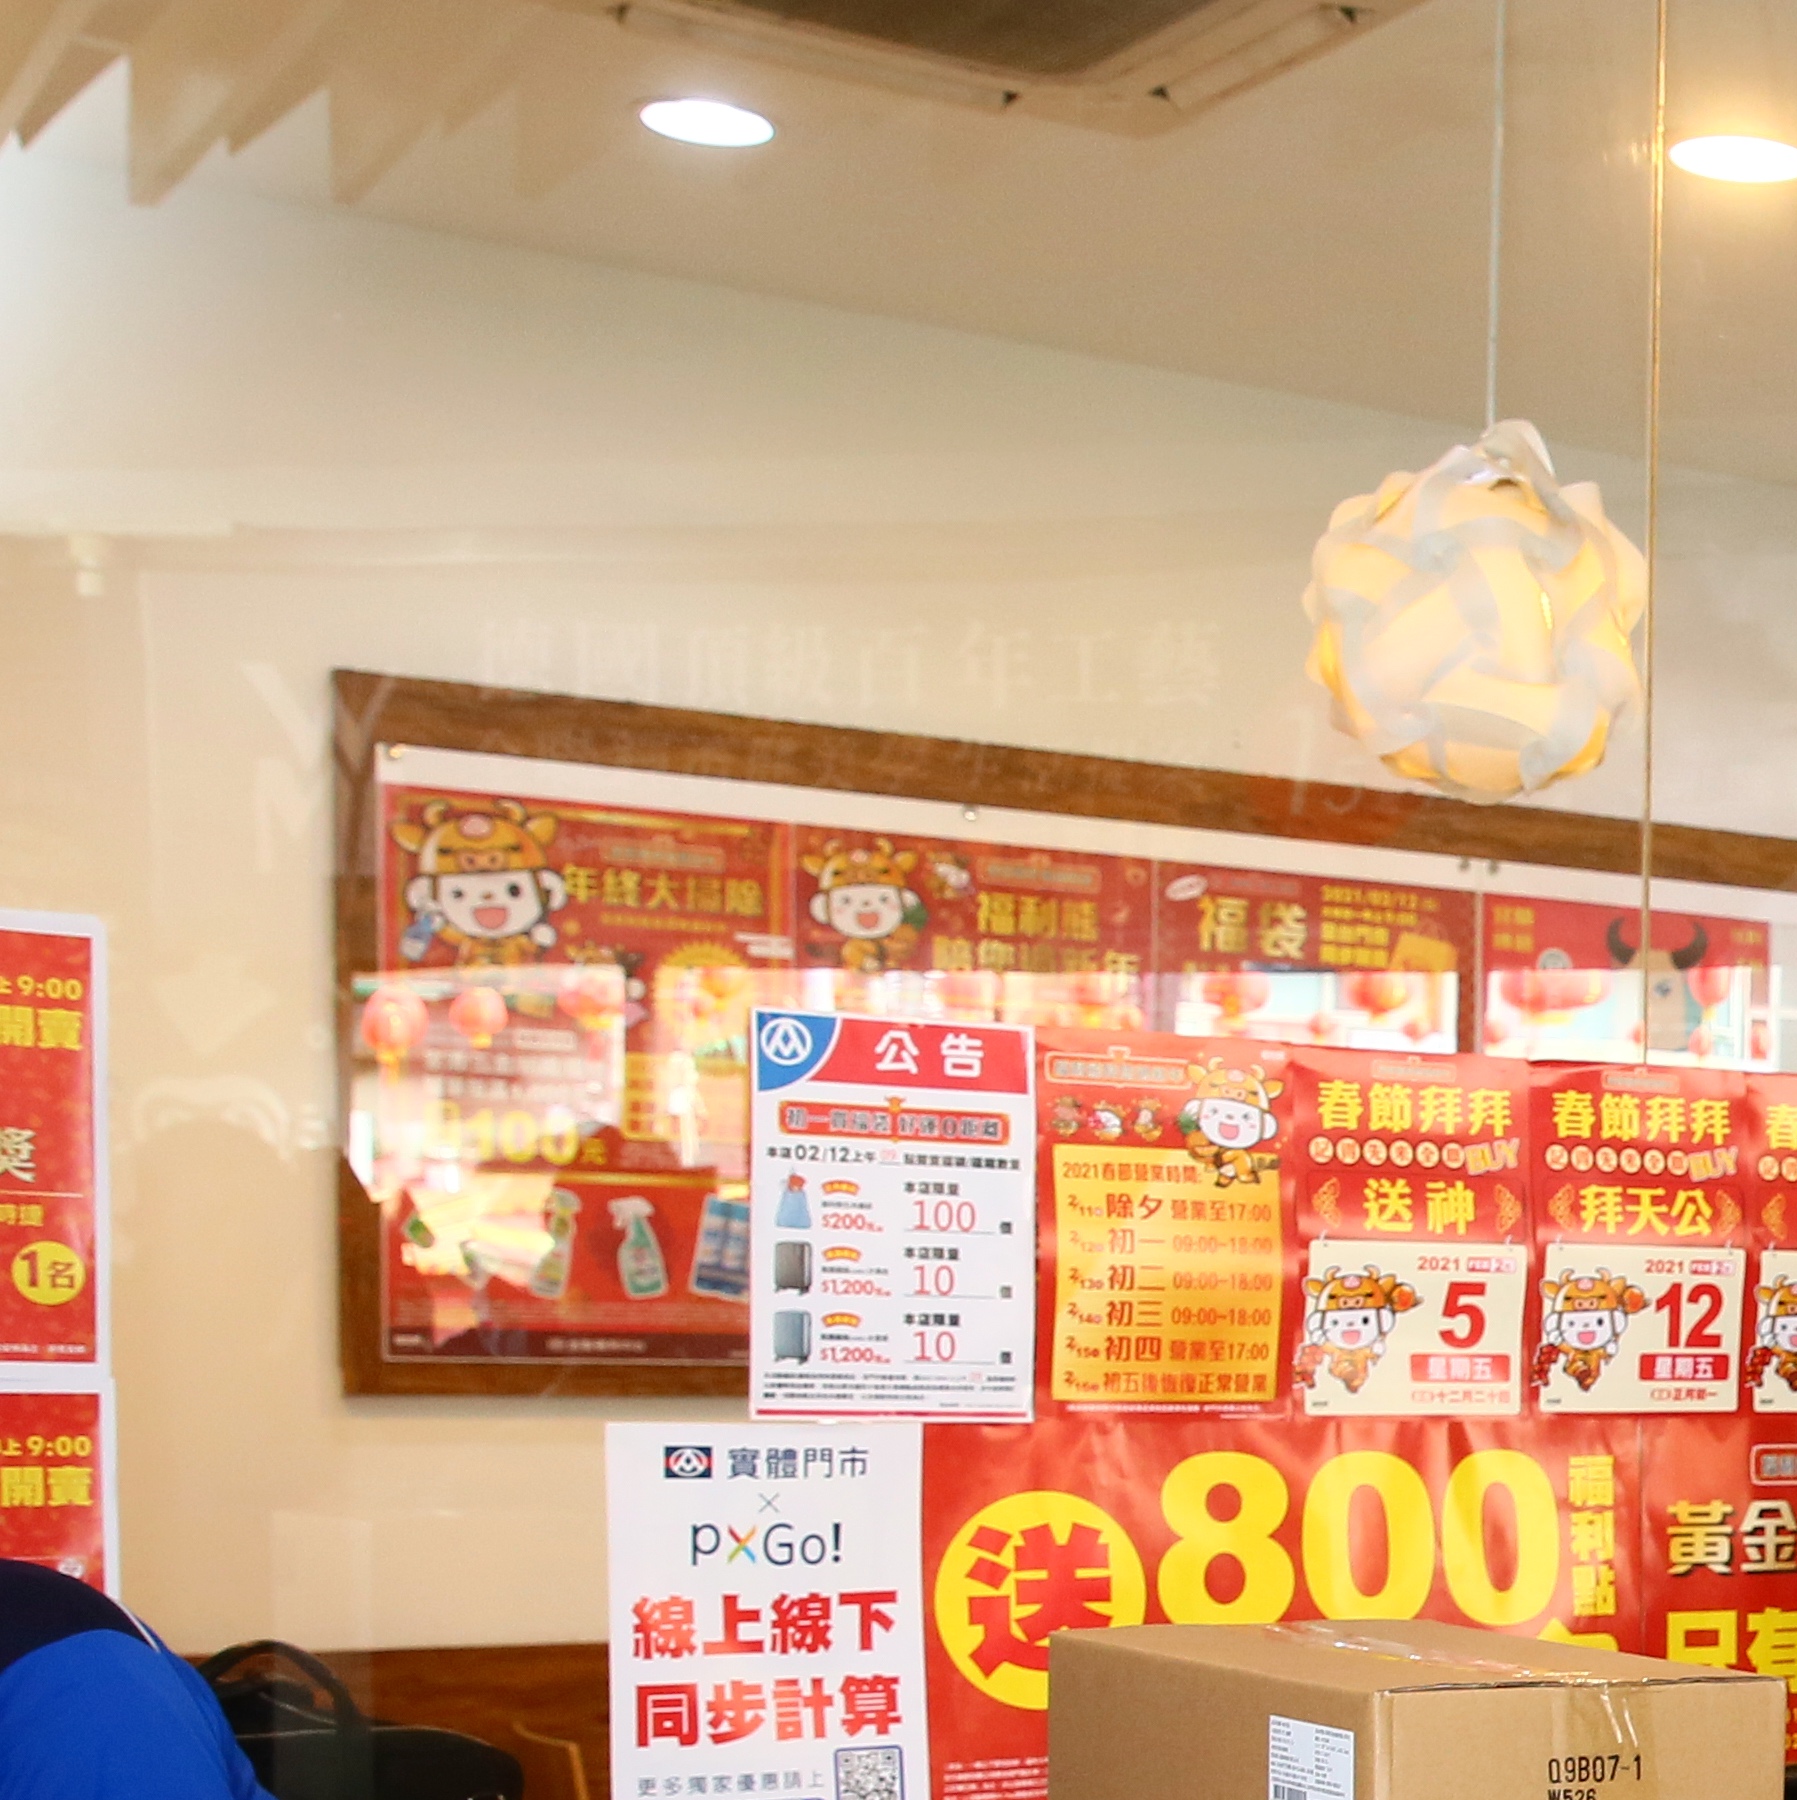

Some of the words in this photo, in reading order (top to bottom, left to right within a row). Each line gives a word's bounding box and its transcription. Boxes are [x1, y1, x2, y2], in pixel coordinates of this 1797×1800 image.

[18, 975, 84, 1000] 9:00
[874, 1029, 984, 1078] 公告
[1317, 1080, 1512, 1136] 春節拜拜
[1551, 1089, 1731, 1145] 春節拜拜
[1464, 1139, 1521, 1176] BUY
[1687, 1147, 1739, 1182] BUY
[913, 1200, 976, 1233] 100
[1106, 1193, 1163, 1220] 除夕
[1363, 1177, 1476, 1235] 送神
[1579, 1184, 1714, 1237] 拜天公
[1108, 1228, 1165, 1254] 初一
[19, 1250, 77, 1290] 1名
[913, 1264, 955, 1297] 10
[1108, 1265, 1165, 1291] 初二
[1417, 1257, 1461, 1272] 2021
[1644, 1259, 1685, 1274] 2021
[1107, 1300, 1163, 1327] 初三
[1438, 1281, 1487, 1349] 5
[1655, 1281, 1723, 1349] 12
[913, 1330, 956, 1363] 10
[1106, 1336, 1162, 1362] 初四
[1427, 1356, 1493, 1380] 星期五
[1653, 1357, 1714, 1379] 星期五
[26, 1434, 92, 1457] 9:00
[727, 1446, 870, 1480] 實體門市
[1569, 1454, 1616, 1619] 福利點
[965, 1521, 1113, 1680] 送
[1157, 1449, 1560, 1626] 800
[631, 1589, 898, 1660] 線上線下
[636, 1674, 902, 1748] 同步計算
